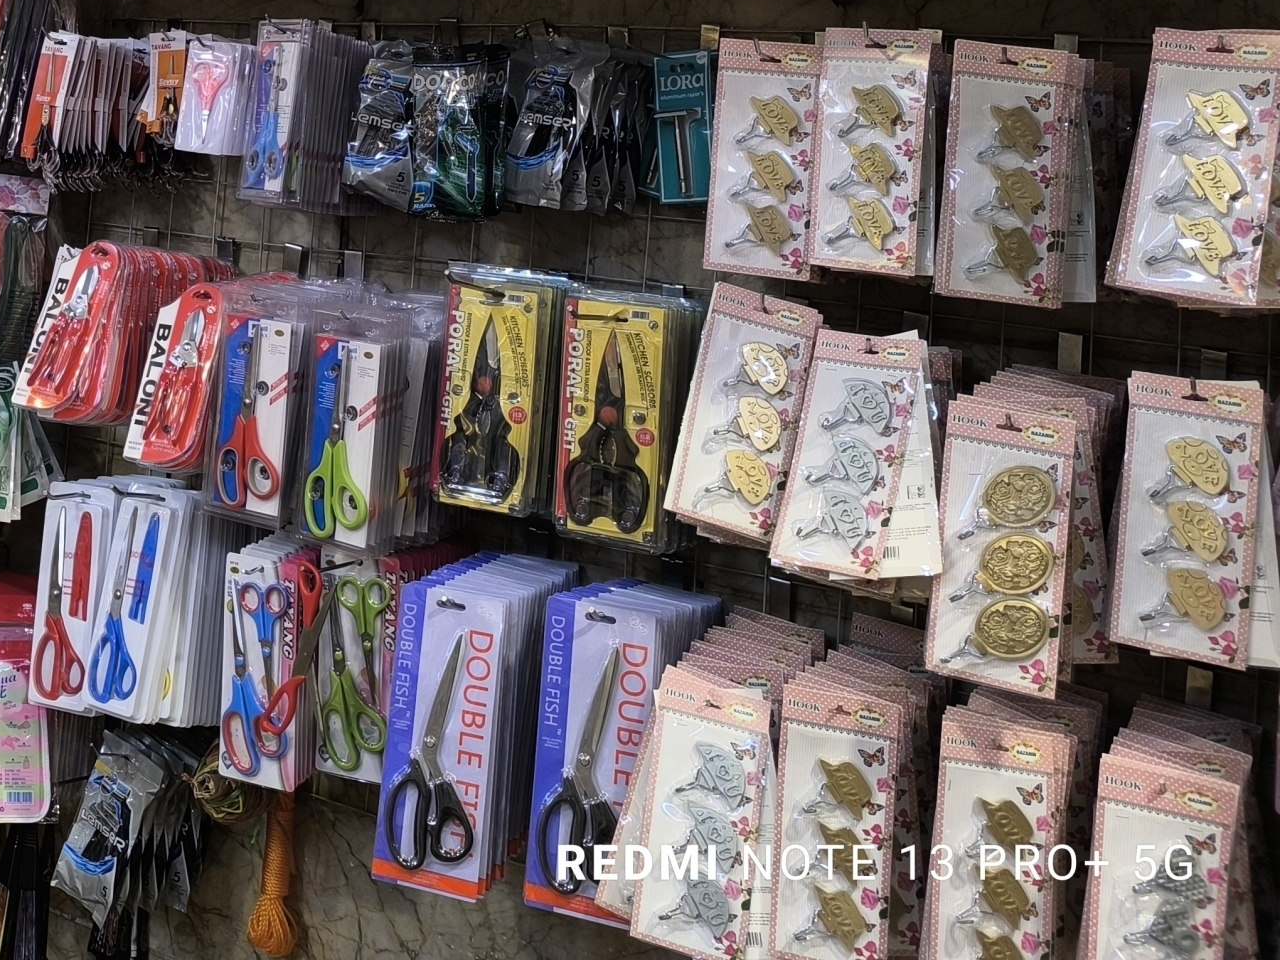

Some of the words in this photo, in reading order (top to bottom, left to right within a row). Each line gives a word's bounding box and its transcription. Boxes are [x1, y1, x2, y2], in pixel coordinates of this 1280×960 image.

[723, 49, 753, 59] HOOK
[960, 52, 990, 62] HOOK
[1160, 40, 1196, 51] HOOK
[718, 294, 746, 307] HOOK
[509, 316, 523, 349] KITCHEN
[822, 341, 850, 351] HOOK
[634, 333, 648, 366] KITCHEN
[644, 369, 656, 409] SCISSORS
[952, 414, 987, 427] HOOK
[398, 603, 416, 670] DOUBLE
[547, 616, 566, 685] DOUBLE
[394, 671, 410, 708] FISH
[457, 630, 494, 769] DOUBLE
[544, 687, 560, 726] FISH
[173, 872, 180, 883] 5
